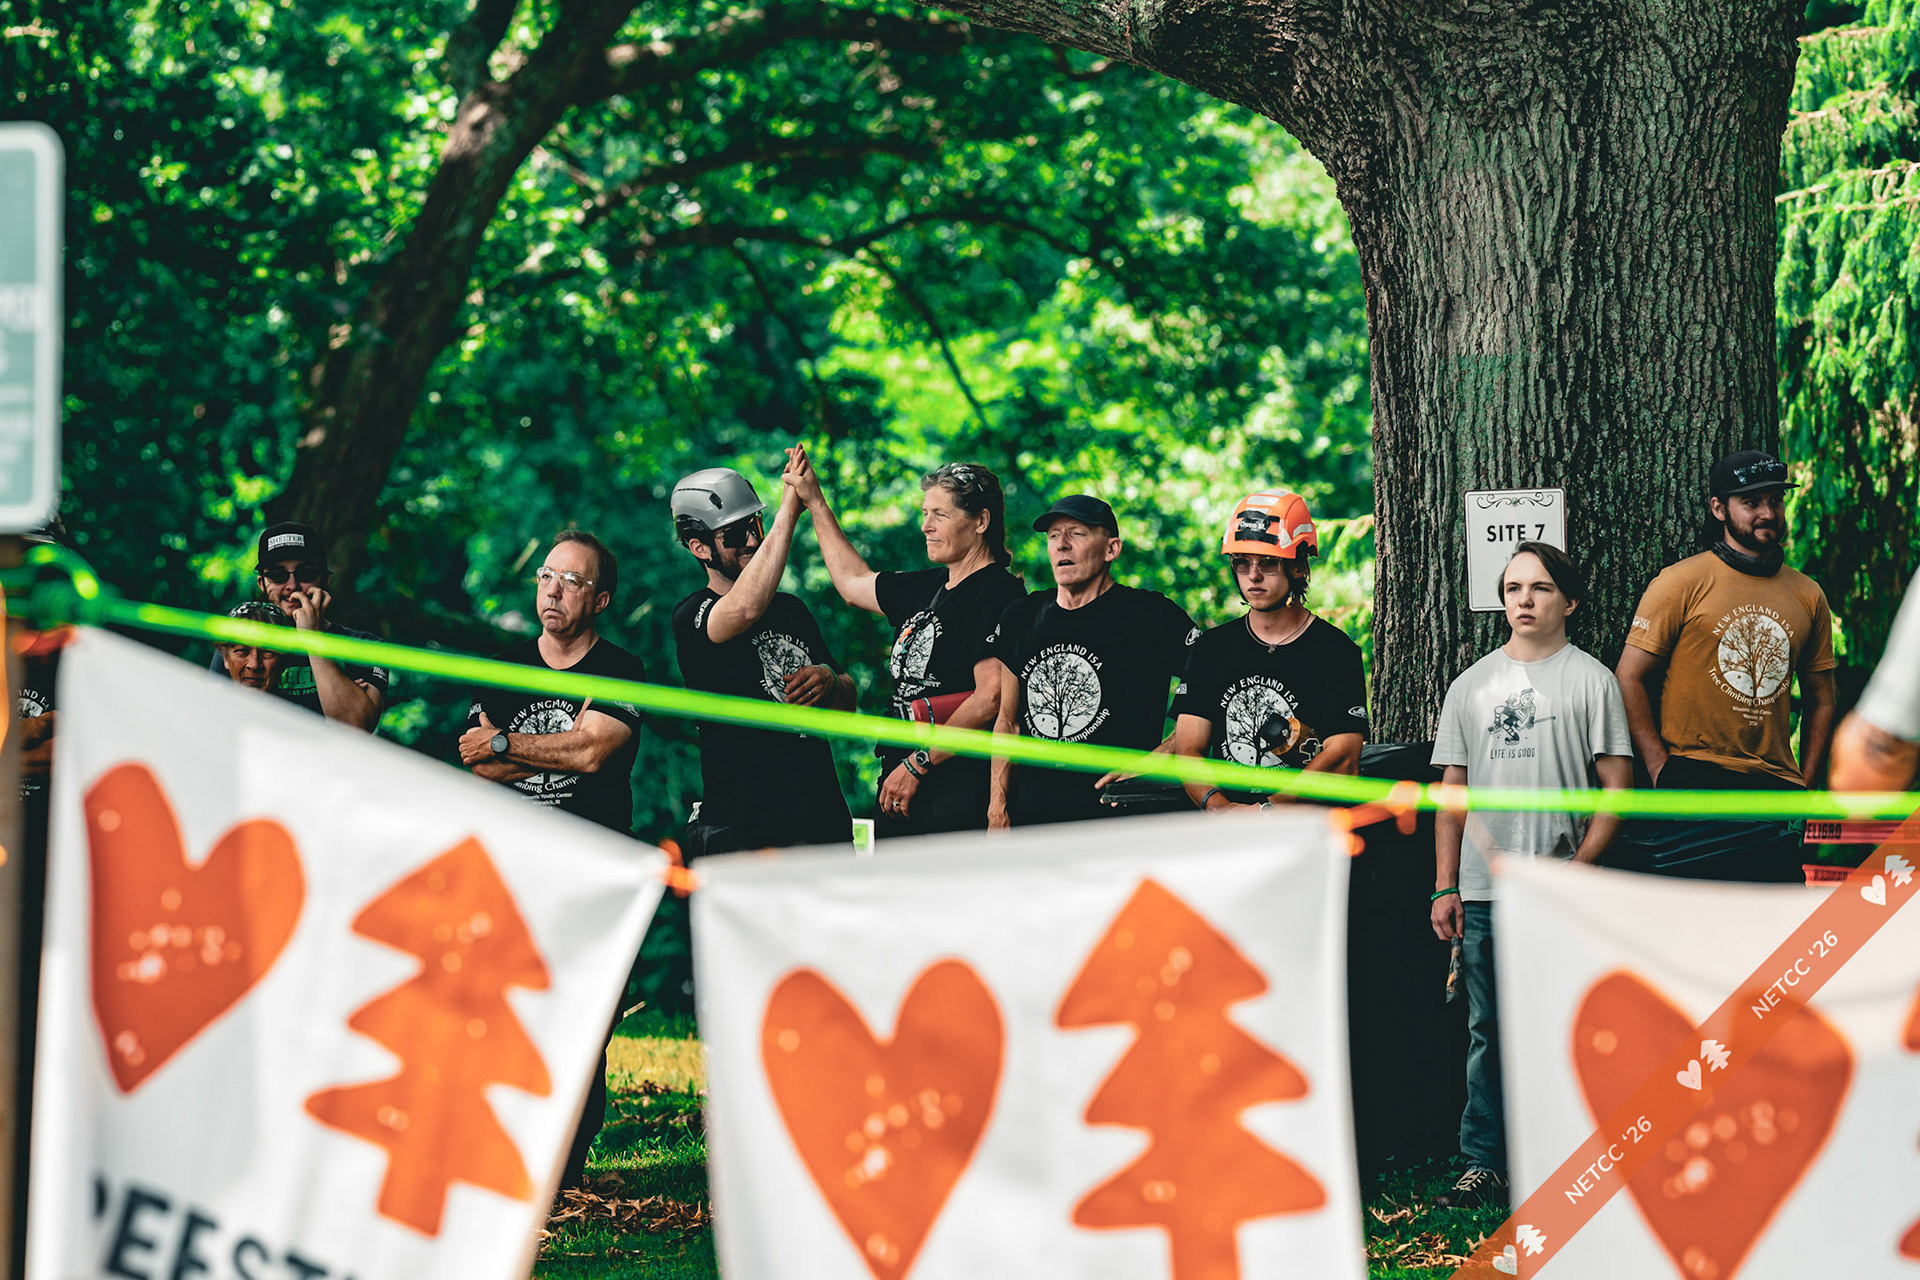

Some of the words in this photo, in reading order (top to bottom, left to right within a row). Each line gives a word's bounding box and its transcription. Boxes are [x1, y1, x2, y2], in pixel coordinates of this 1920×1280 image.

[1487, 524, 1526, 542] SITE
[1535, 524, 1546, 541] 7
[1712, 613, 1731, 636] NEW
[1732, 604, 1780, 620] ENGLAND
[1780, 619, 1795, 638] ISA
[1021, 656, 1037, 680] NEW
[1040, 643, 1087, 659] ENGLAND
[1087, 653, 1103, 671] ISA
[1220, 683, 1237, 709] NEW
[1240, 674, 1284, 692] ENGLAND
[1284, 690, 1299, 710] ISA
[1708, 666, 1721, 686] Tree
[1720, 684, 1753, 707] Climbing
[509, 708, 528, 732] NEW
[1058, 708, 1111, 746] Championship
[1490, 749, 1505, 759] LIFE
[1508, 748, 1516, 758] IS
[1517, 747, 1535, 758] GOOD
